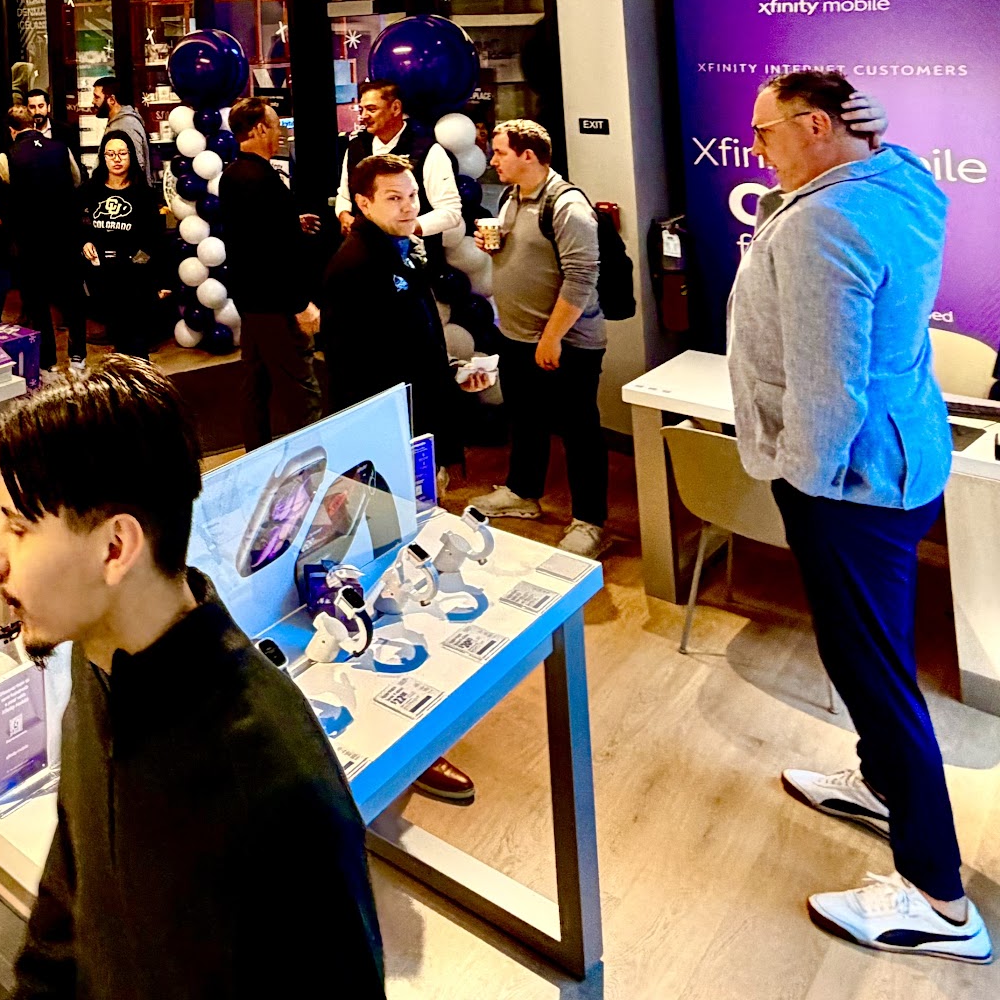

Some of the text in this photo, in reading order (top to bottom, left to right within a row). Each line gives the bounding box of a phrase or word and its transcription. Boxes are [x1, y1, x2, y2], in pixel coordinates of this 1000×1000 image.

[697, 63, 758, 74] XFINITY
[853, 64, 968, 77] CUSTOMERS
[583, 120, 604, 129] EXIT
[93, 220, 132, 231] COLORADO
